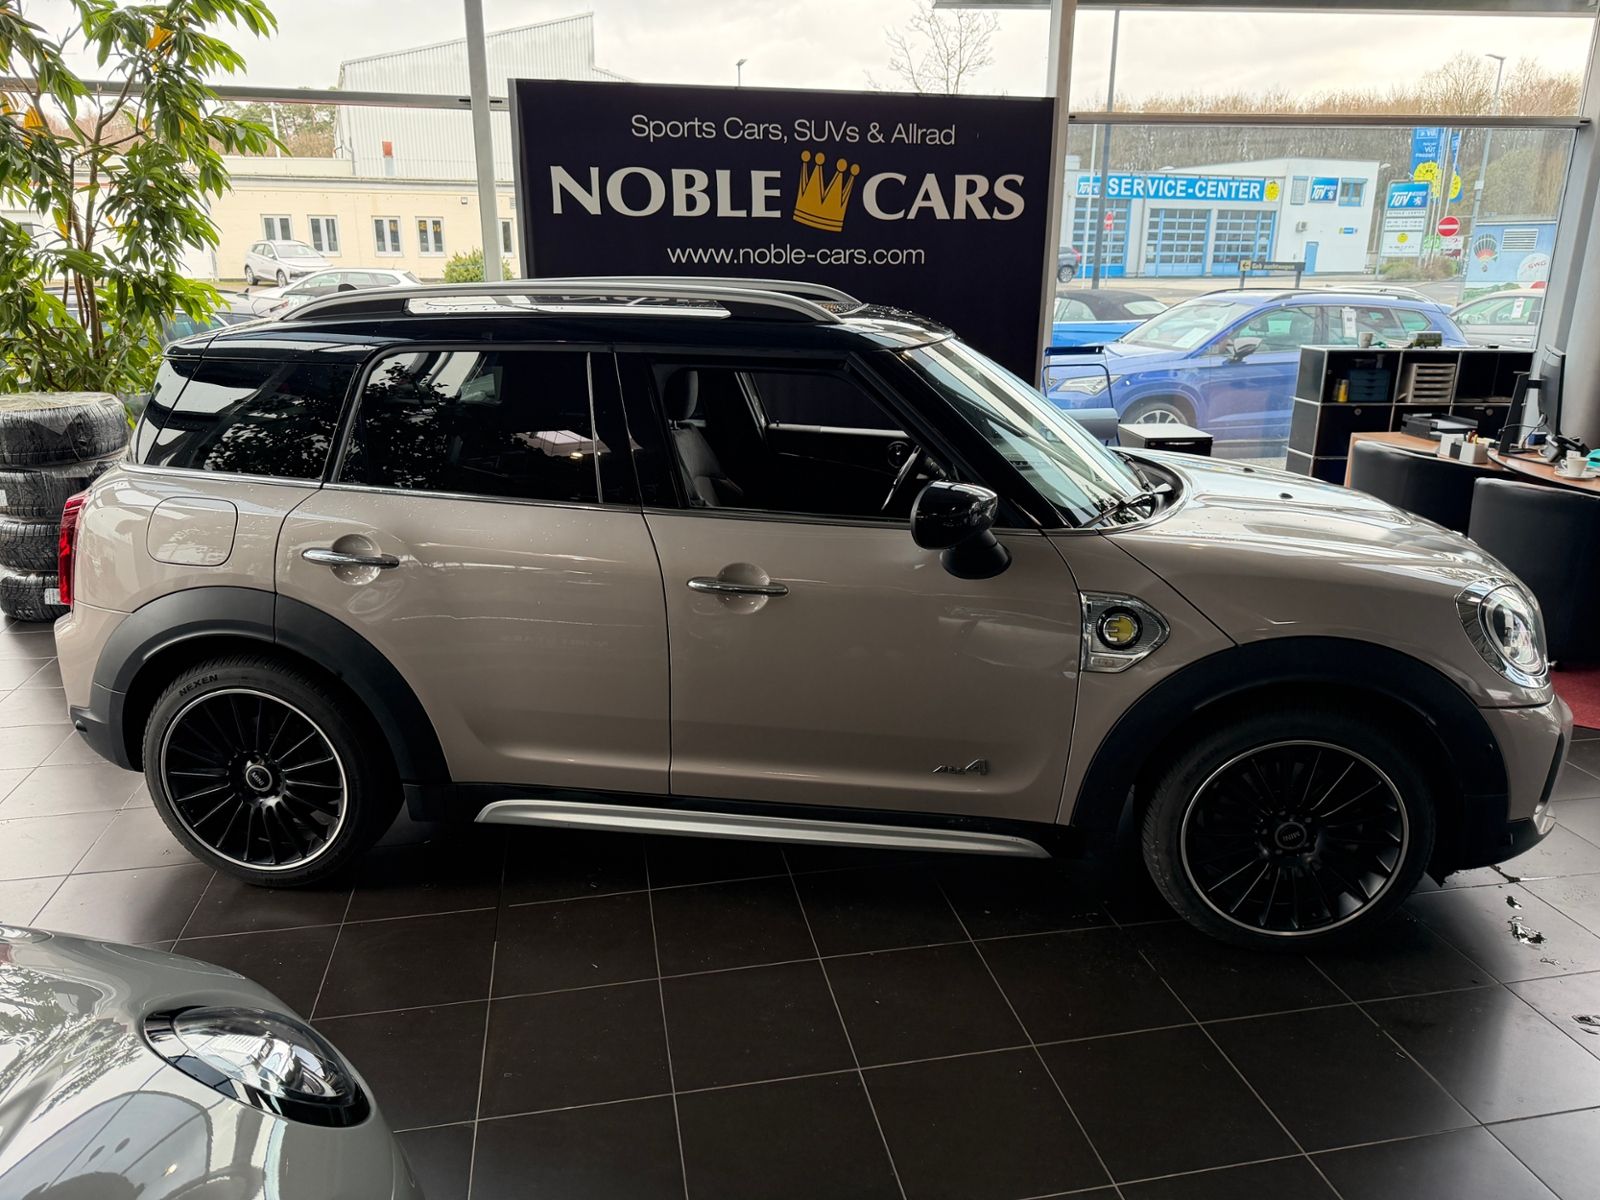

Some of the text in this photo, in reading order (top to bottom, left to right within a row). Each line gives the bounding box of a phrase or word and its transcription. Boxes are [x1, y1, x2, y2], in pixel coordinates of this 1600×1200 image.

[631, 114, 956, 146] Sports Cars, SUVs & Allrad
[550, 165, 1026, 221] NOBLE CARS
[1107, 177, 1262, 199] SERVICE-CENTER
[667, 243, 926, 266] www.noble-cars.com
[179, 674, 218, 697] NEXEN
